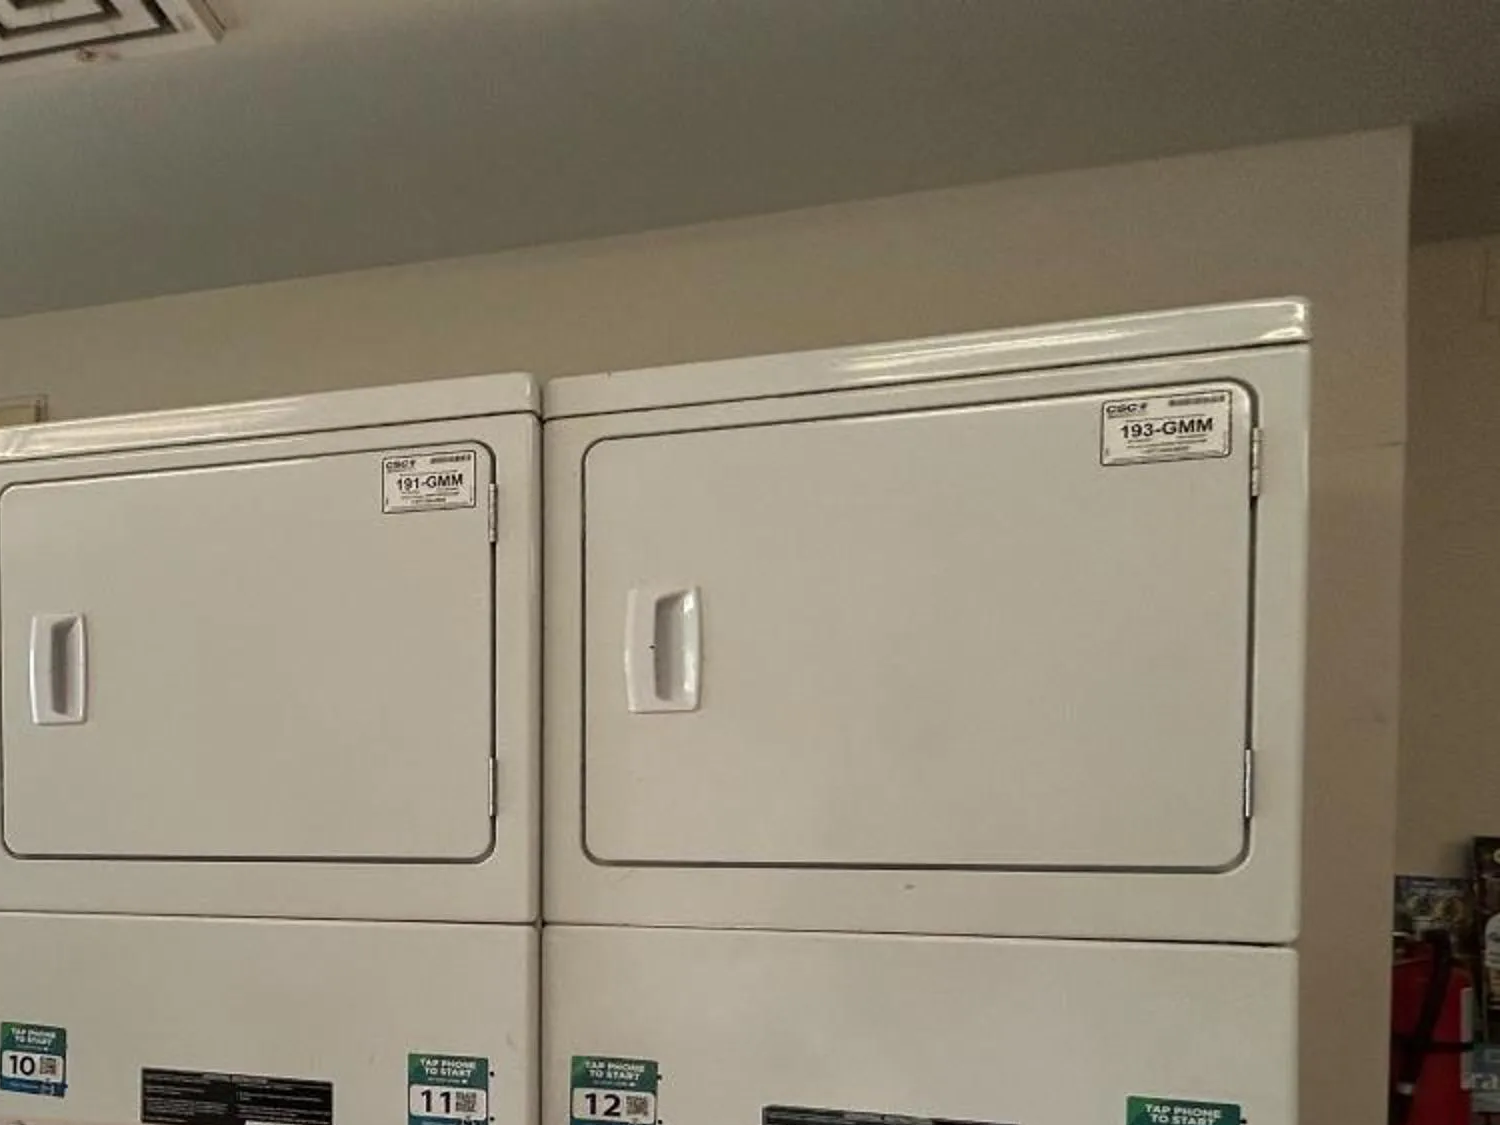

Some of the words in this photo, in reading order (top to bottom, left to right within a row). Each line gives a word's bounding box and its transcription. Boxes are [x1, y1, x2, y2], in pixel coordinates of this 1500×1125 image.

[1120, 417, 1213, 438] 193-GMM
[397, 473, 463, 490] 191-GMM
[9, 1055, 35, 1076] 10
[421, 1089, 450, 1114] 11
[585, 1093, 621, 1116] 12
[1145, 1103, 1171, 1113] TAP
[1173, 1106, 1222, 1118] PHONE
[1151, 1114, 1169, 1123] TO
